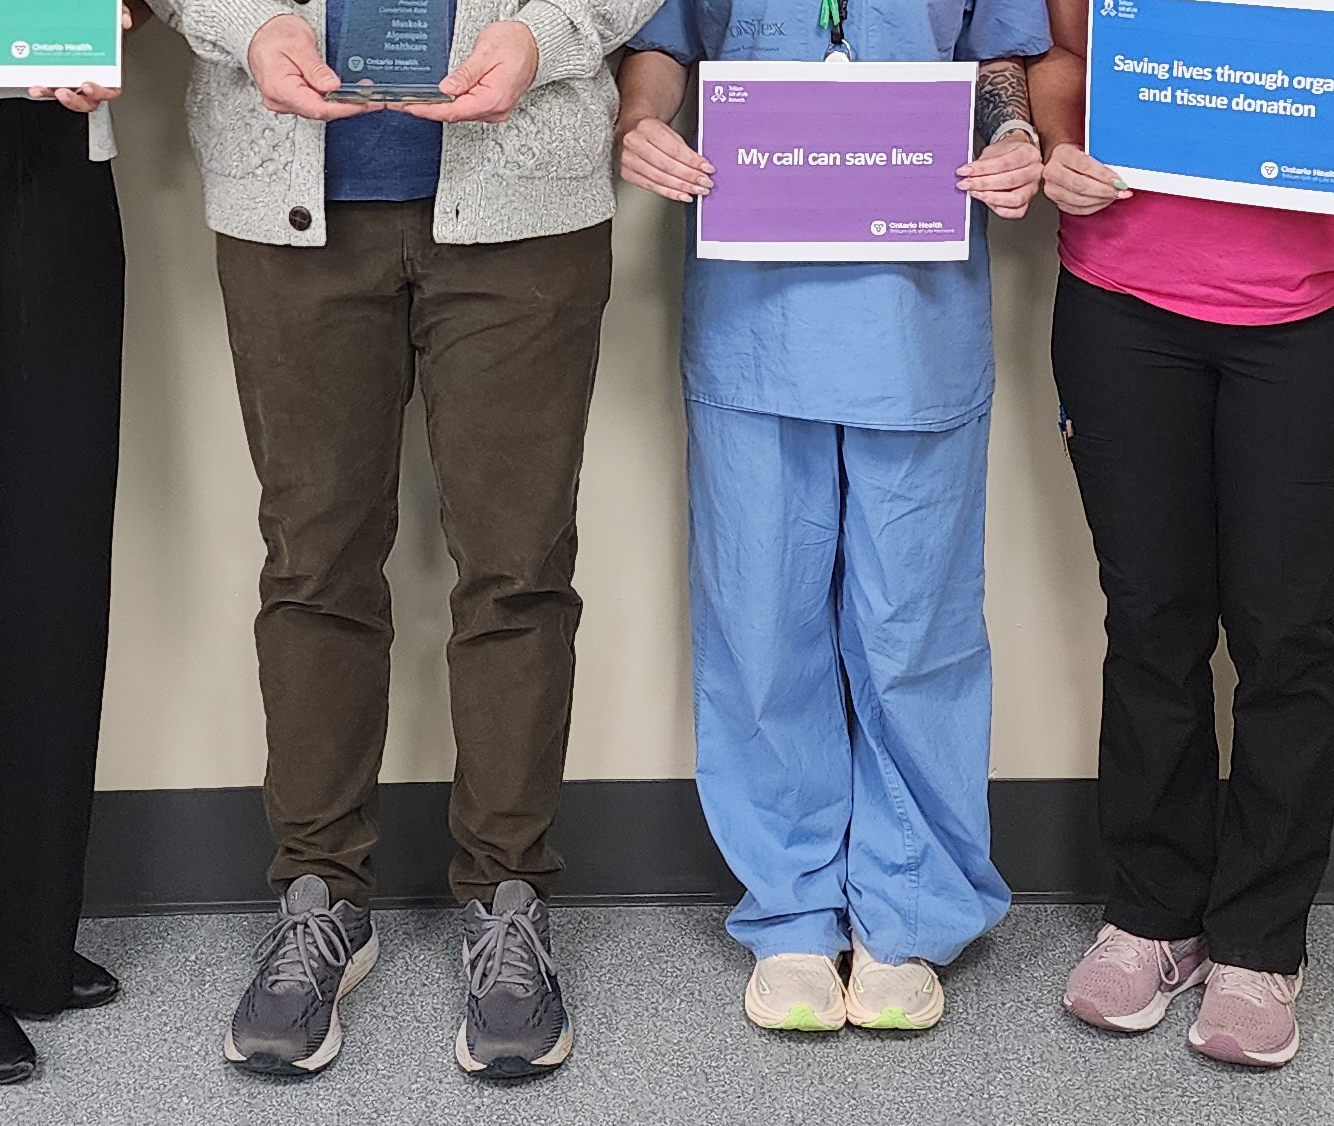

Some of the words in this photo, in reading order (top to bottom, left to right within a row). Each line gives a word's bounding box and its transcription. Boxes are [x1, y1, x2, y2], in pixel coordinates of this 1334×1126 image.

[1113, 54, 1170, 80] Saving
[1172, 60, 1213, 81] lives
[1215, 64, 1290, 91] through
[1138, 85, 1172, 104] and
[1174, 87, 1229, 110] tissue
[1231, 94, 1317, 118] donation
[737, 148, 769, 169] My
[772, 147, 804, 166] call
[808, 151, 841, 166] can
[844, 151, 888, 166] save
[891, 147, 934, 166] lives
